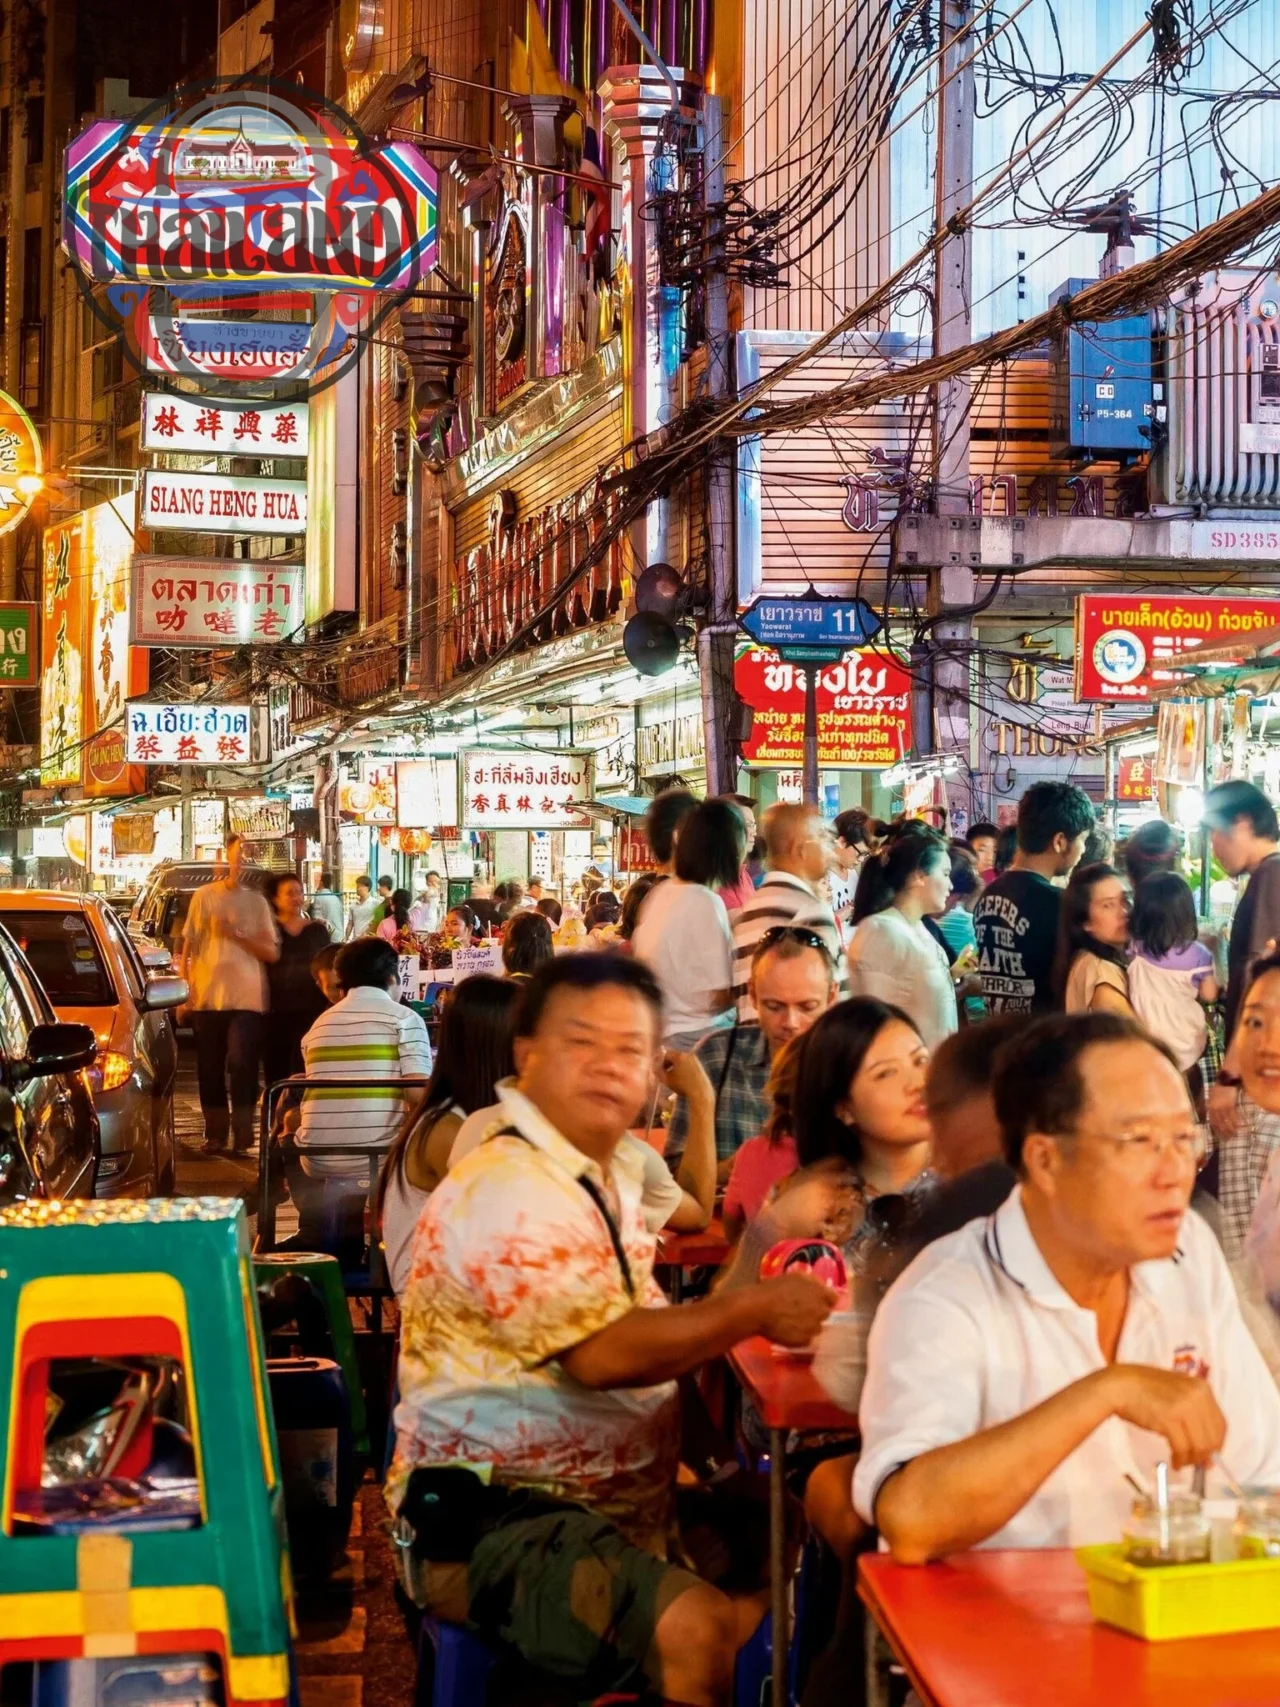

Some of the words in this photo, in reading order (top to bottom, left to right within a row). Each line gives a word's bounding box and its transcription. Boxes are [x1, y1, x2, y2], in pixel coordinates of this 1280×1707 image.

[150, 485, 204, 516] SIANG
[209, 488, 258, 518] HENG
[263, 491, 300, 520] HUA
[151, 572, 291, 606] ตลาดเก่า
[760, 606, 823, 622] เยาวราช
[832, 608, 856, 632] 11
[760, 622, 792, 631] Yaowarat
[1050, 676, 1065, 684] Wat
[991, 925, 1016, 949] THE
[979, 946, 1026, 977] AITH
